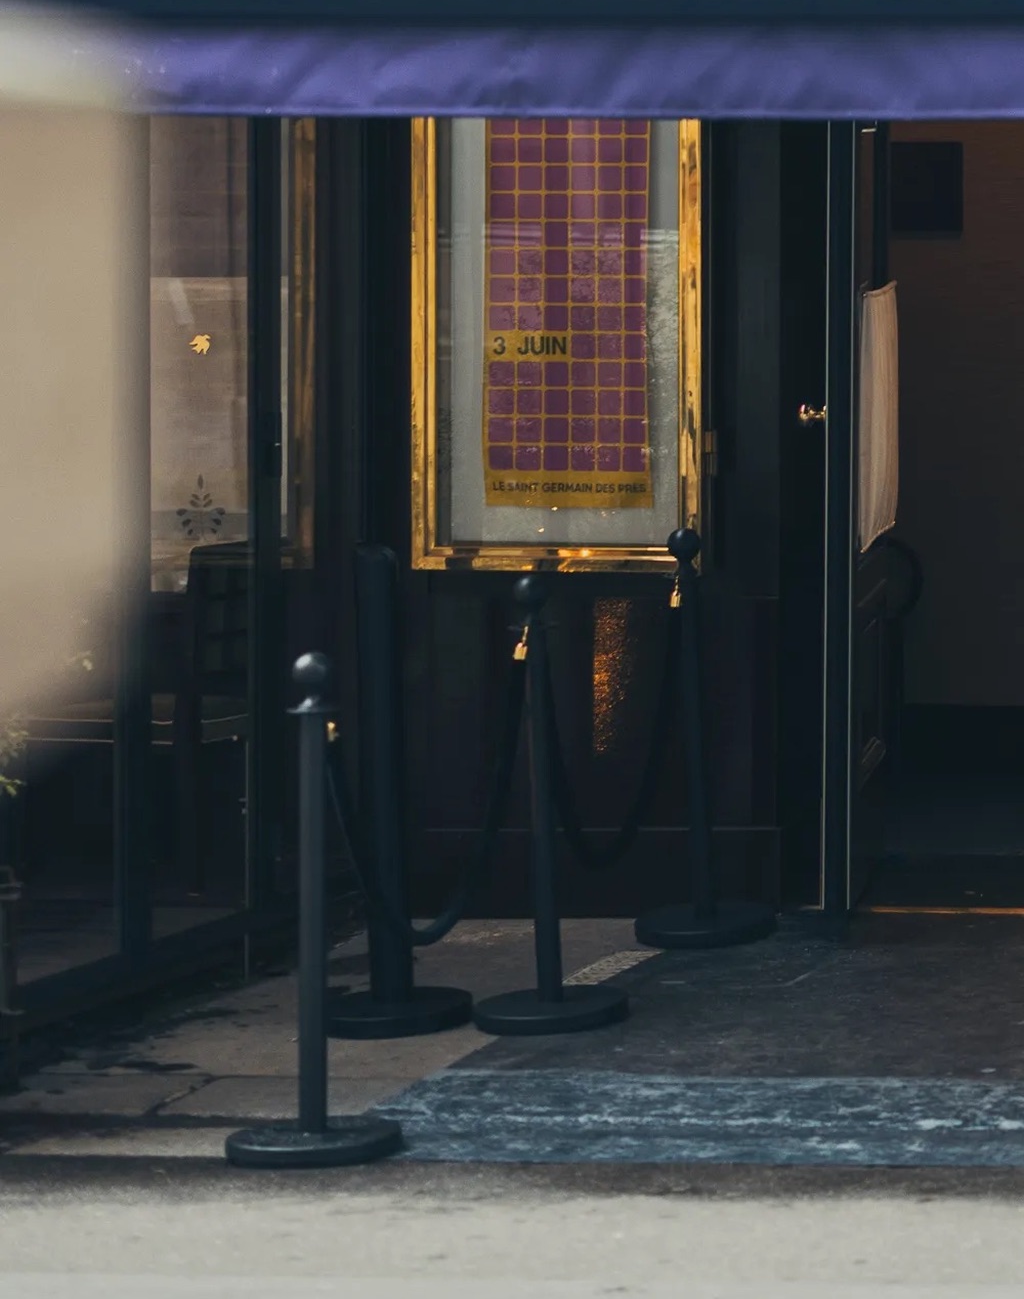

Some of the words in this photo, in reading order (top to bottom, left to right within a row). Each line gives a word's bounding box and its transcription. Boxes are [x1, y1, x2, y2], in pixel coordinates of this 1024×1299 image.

[493, 336, 506, 355] 3
[517, 336, 567, 355] JUIN
[492, 480, 506, 492] LE
[508, 481, 539, 493] SAINT
[541, 482, 594, 494] GERMAIN
[595, 483, 616, 494] DES
[618, 482, 647, 494] PRES
